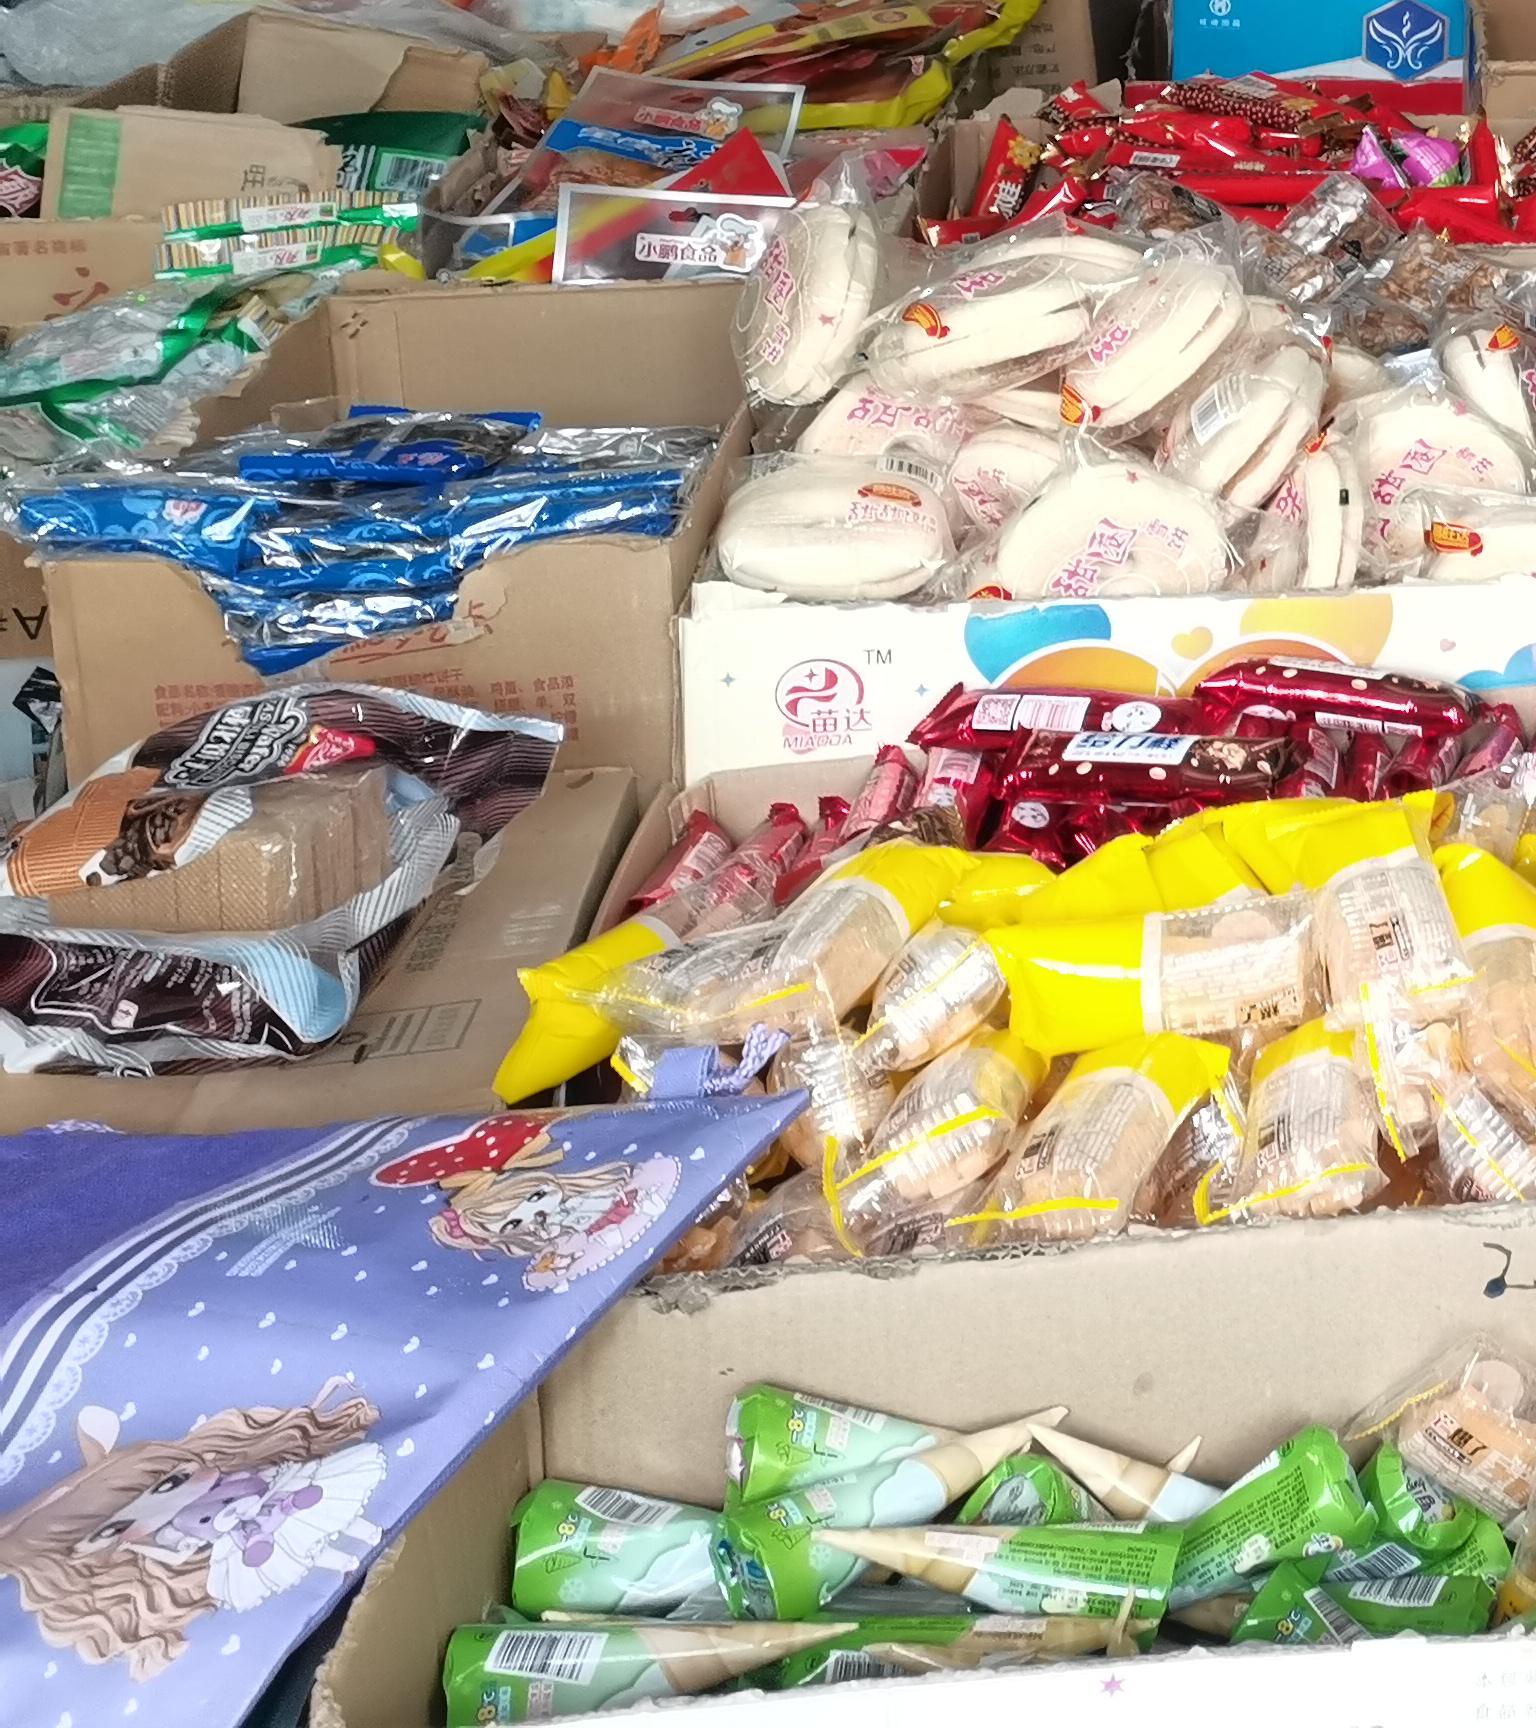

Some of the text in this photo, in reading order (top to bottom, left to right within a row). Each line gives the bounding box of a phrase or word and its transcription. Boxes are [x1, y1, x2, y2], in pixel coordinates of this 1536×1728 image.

[635, 237, 720, 267] 小鹏食品
[864, 648, 893, 666] TM
[810, 707, 873, 735] 苗达
